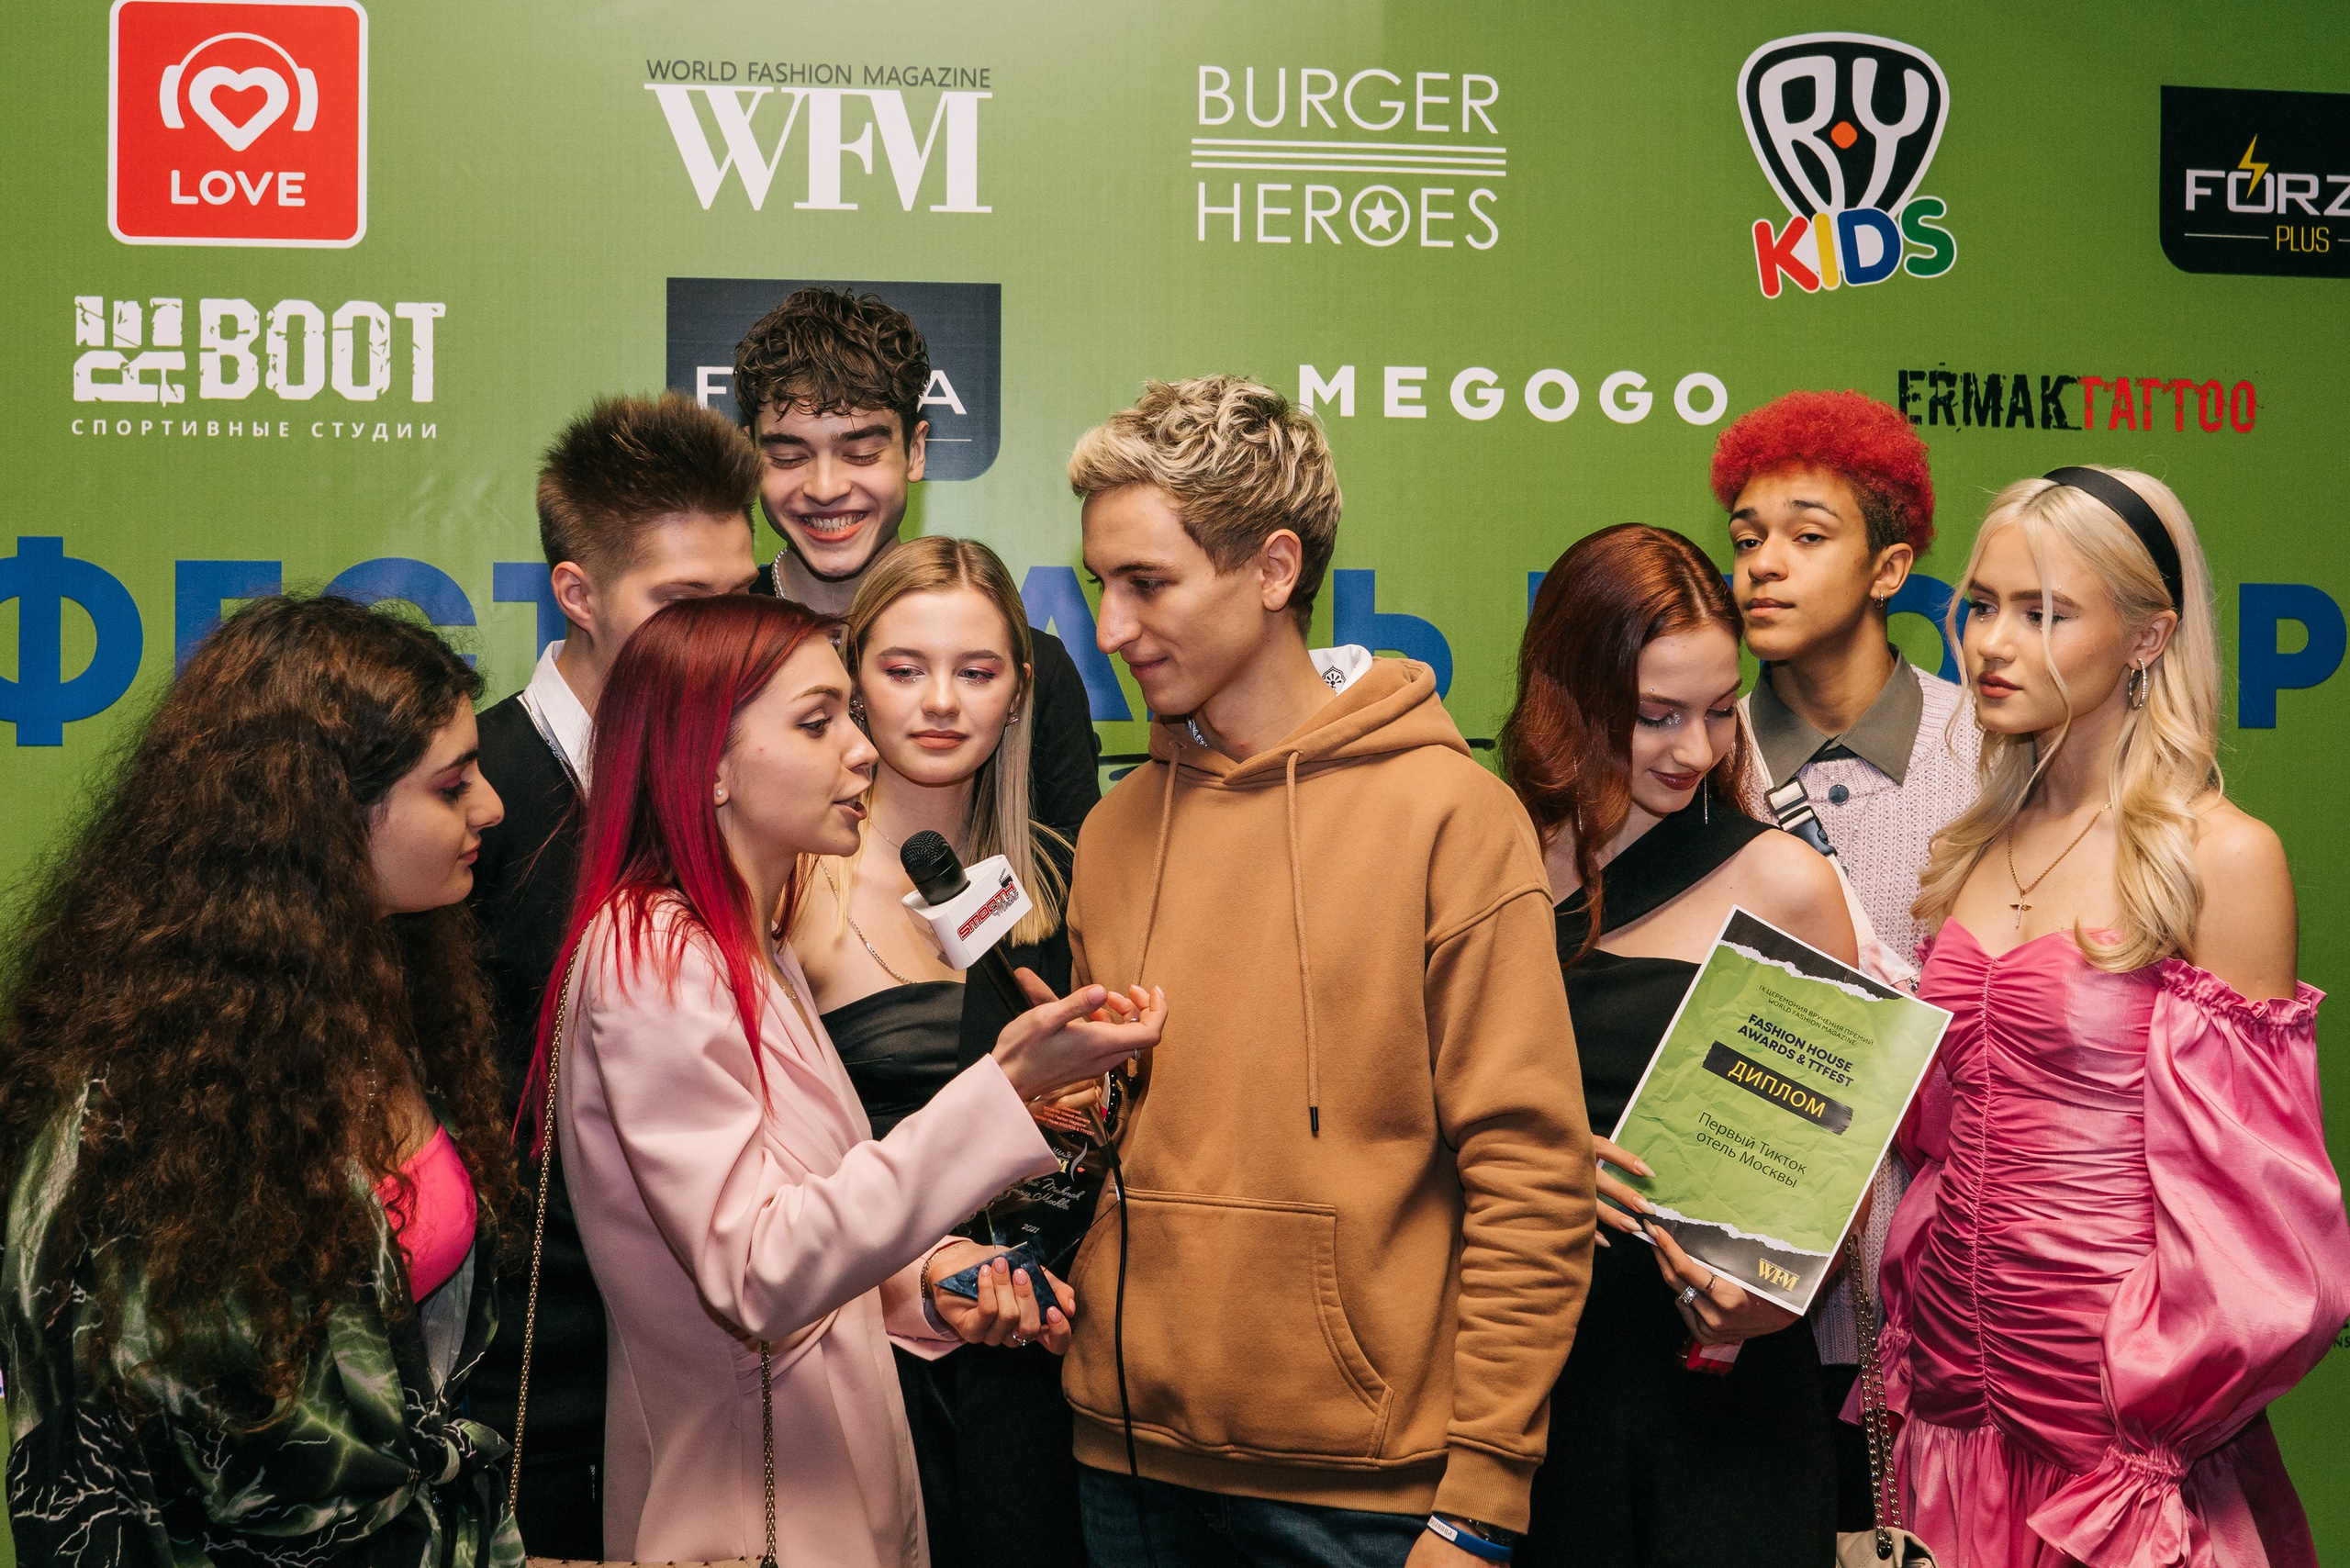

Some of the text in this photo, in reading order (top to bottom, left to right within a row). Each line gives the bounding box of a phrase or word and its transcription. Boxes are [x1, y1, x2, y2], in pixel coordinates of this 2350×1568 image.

[646, 59, 990, 88] WORLD FASHION MAGAZINE
[1198, 64, 1500, 135] BURGER
[644, 84, 992, 213] WFM
[171, 170, 306, 207] LOVE
[1197, 182, 1499, 251] HEROES
[1751, 195, 1957, 298] KIDS
[2276, 225, 2330, 252] PLUS
[1298, 364, 1728, 426] MEGOGO
[71, 420, 438, 443] СПОРТИВНЫЕ СТУДИИ
[1766, 989, 1808, 1014] ЦЕРЕМОНИЯ
[1808, 1010, 1844, 1032] ВРУЧЕНИЯ
[1844, 1028, 1874, 1047] ПРЕМИЙ
[1768, 997, 1792, 1014] WORLD
[1792, 1010, 1821, 1029] FASHION
[1738, 1025, 1854, 1087] AWARDS & TTFEST
[1748, 1014, 1853, 1073] FASHION HOUSE
[1728, 1060, 1826, 1118] ДИПЛОМ
[1696, 1132, 1797, 1188] отель Москвы
[1698, 1112, 1807, 1174] Первый Тикток
[1021, 1224, 1040, 1234] 2021
[1758, 1259, 1800, 1293] WFM
